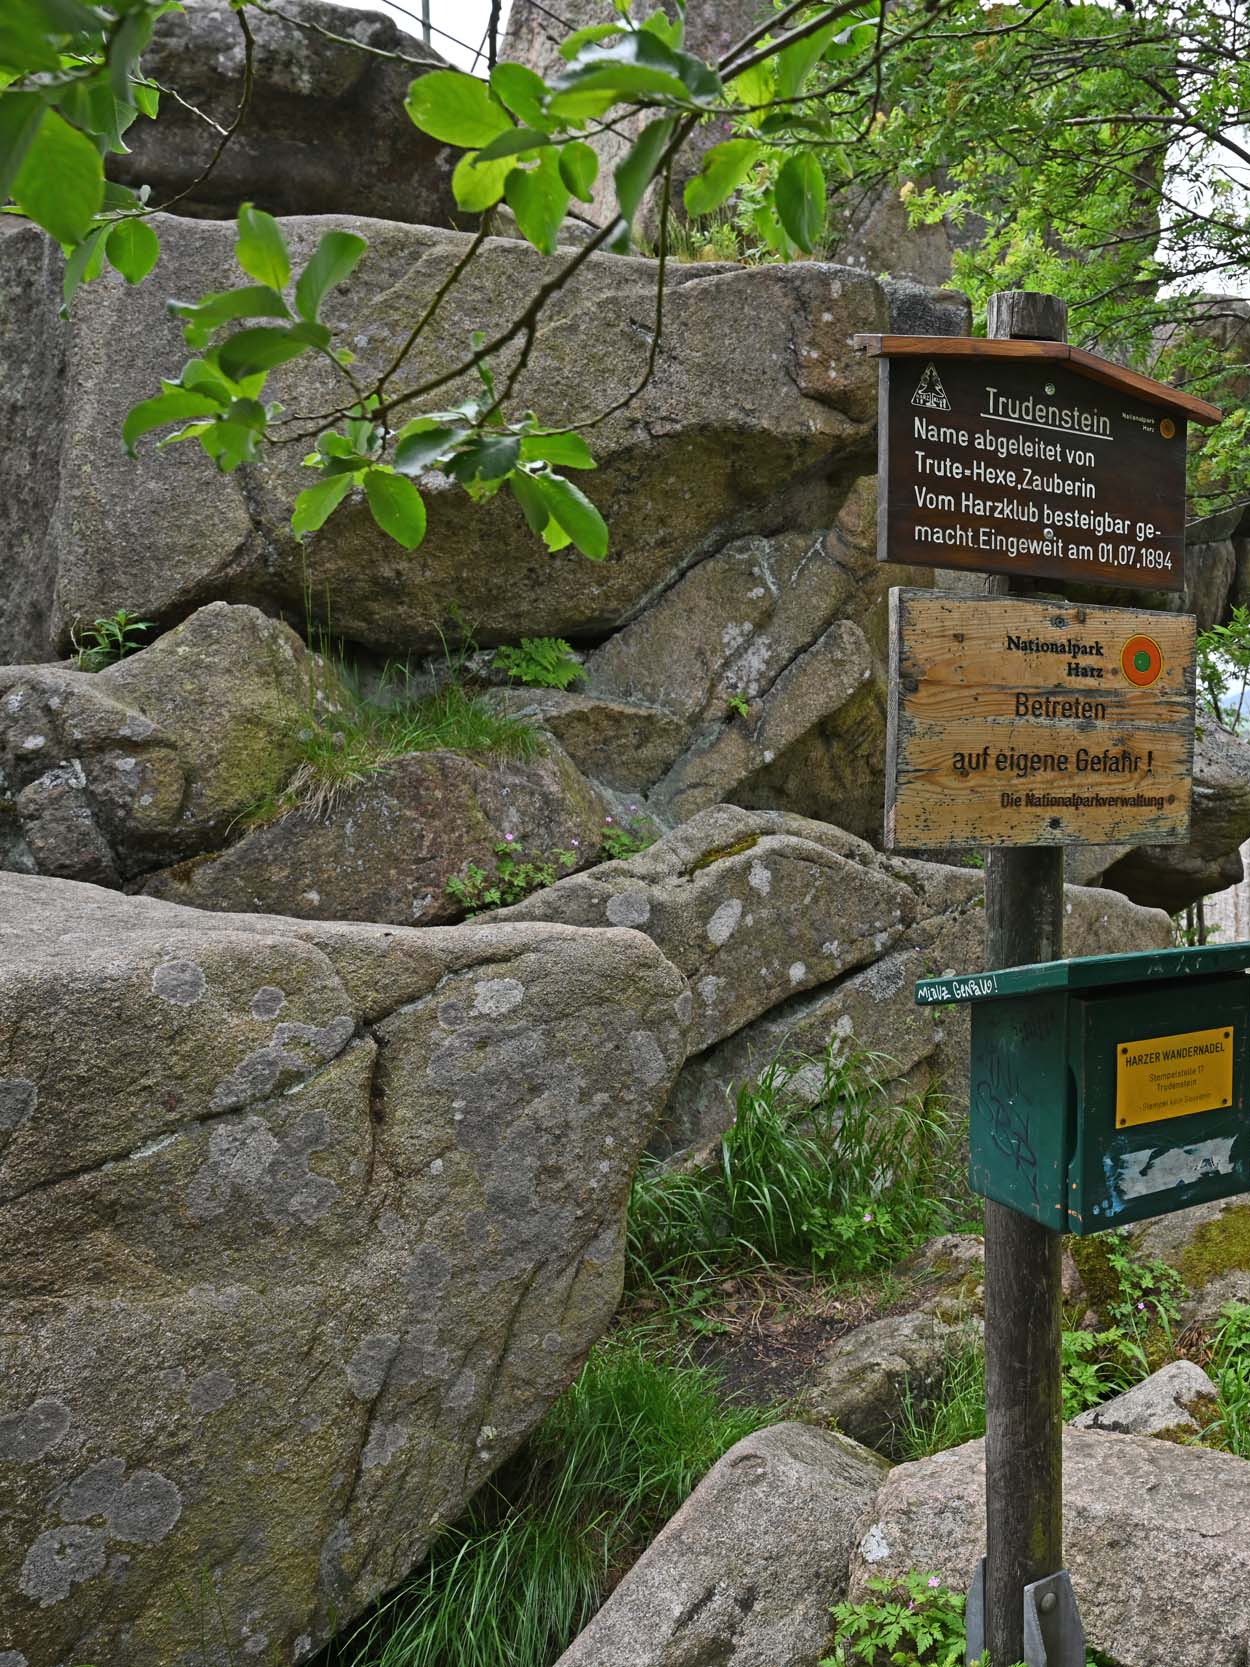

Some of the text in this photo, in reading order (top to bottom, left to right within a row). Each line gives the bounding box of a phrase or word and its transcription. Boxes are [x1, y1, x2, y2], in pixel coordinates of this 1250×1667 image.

[985, 387, 1110, 435] Trudenstein
[914, 416, 1096, 468] Name abgeleitet von
[914, 485, 1161, 542] Vom Harzklub besteigbar ge-
[1068, 543, 1094, 561] am
[1006, 635, 1104, 658] Nationalpark
[1066, 661, 1104, 679] Harz
[1014, 692, 1106, 721] Betreten
[952, 746, 990, 772] auf
[995, 749, 1069, 778] eigene
[1001, 792, 1165, 811] Die Nationalparkverwaltung
[1125, 1041, 1225, 1068] HARZER WANDERNADEL
[1156, 1079, 1197, 1093] Trudenstein
